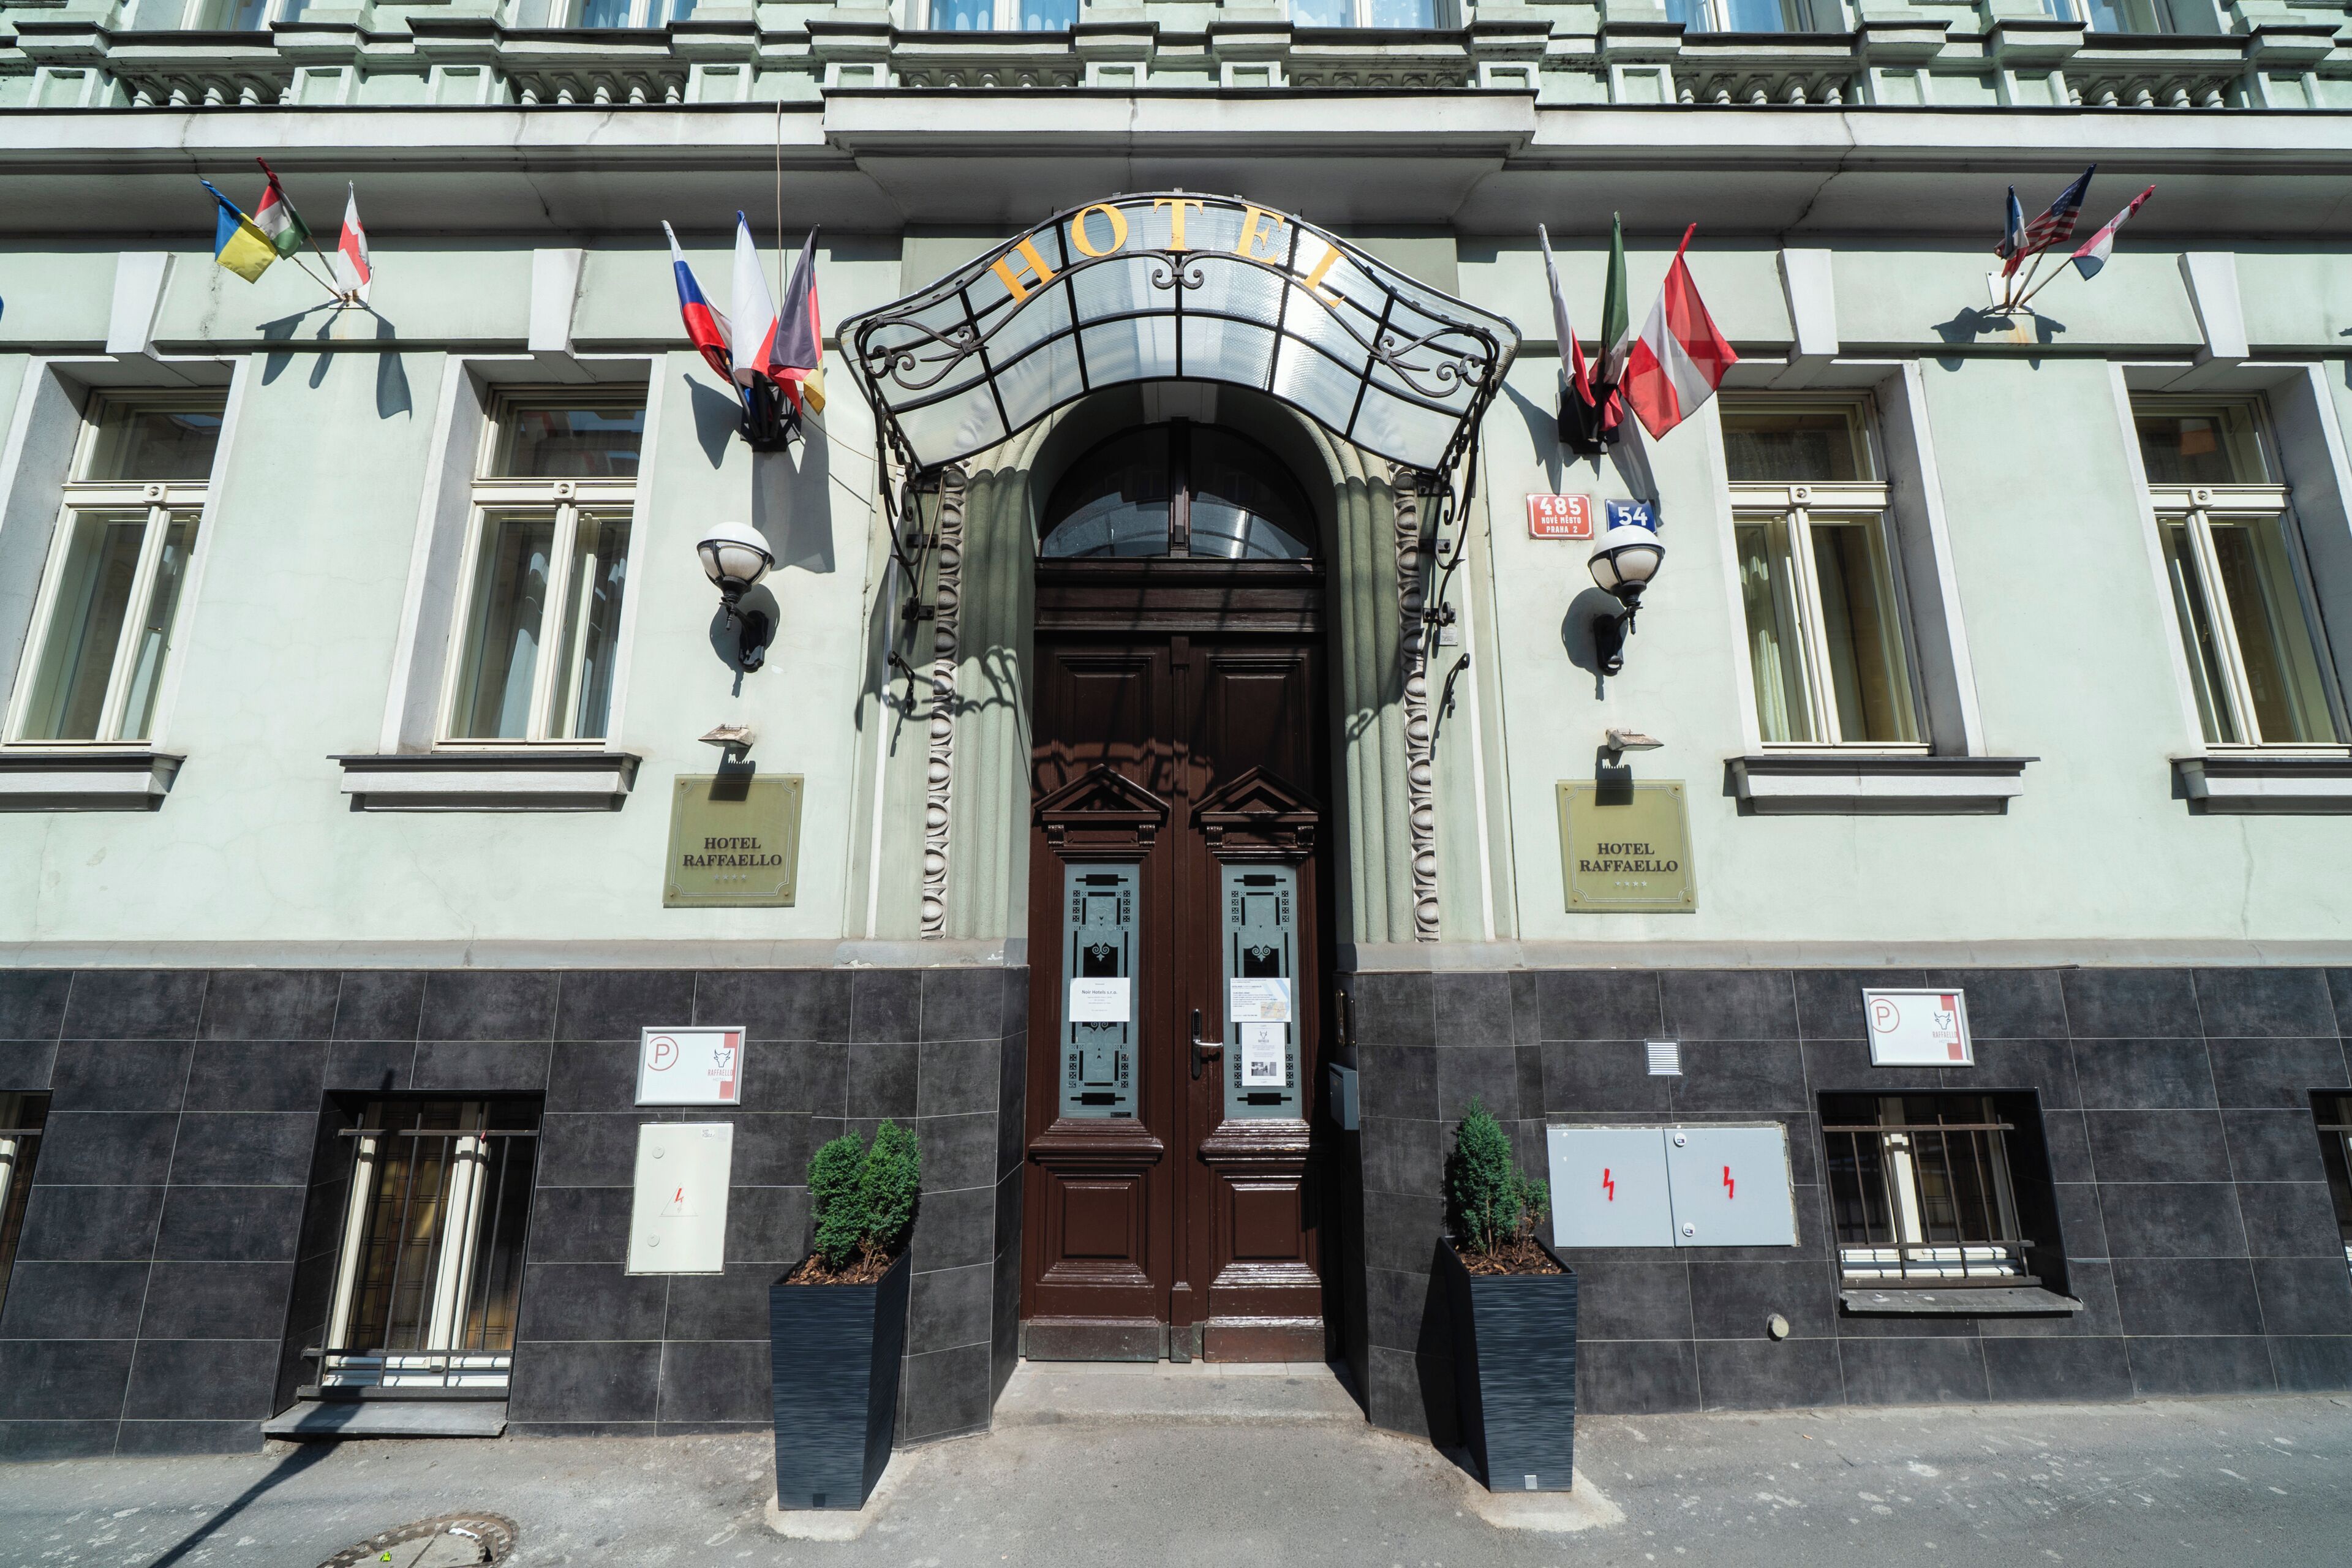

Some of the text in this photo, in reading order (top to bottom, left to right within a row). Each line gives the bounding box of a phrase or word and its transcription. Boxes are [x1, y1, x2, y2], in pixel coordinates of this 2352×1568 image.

[986, 198, 1348, 309] HOTEL
[1540, 497, 1581, 515] 485
[1541, 514, 1581, 524] NOVÉ MĚSTO
[1618, 507, 1648, 526] 54
[704, 837, 761, 850] HOTEL
[1597, 843, 1655, 855] HOTEL
[682, 854, 782, 867] RAFFAELLO
[1579, 860, 1678, 872] RAFFAELLO
[1875, 1006, 1890, 1026] P
[655, 1044, 670, 1063] P
